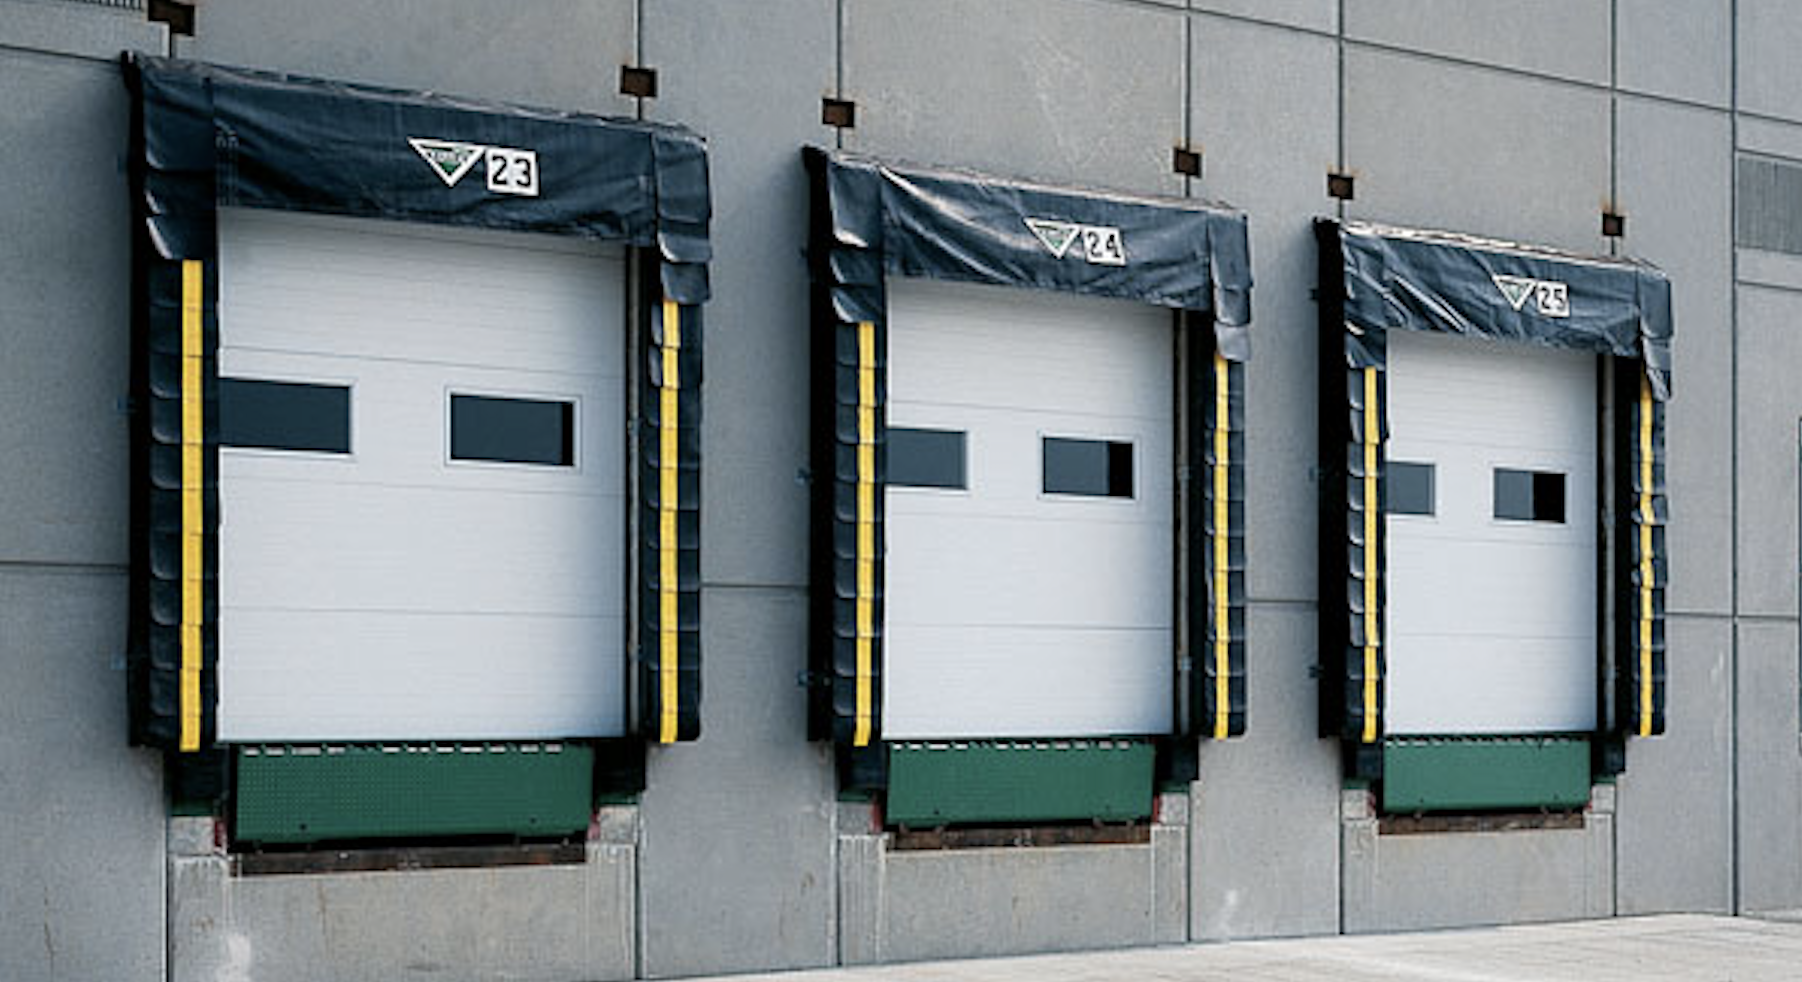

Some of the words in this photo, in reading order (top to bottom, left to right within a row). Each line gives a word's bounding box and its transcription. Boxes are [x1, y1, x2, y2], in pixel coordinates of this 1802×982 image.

[491, 155, 531, 187] 23
[1087, 231, 1121, 258] 24
[1540, 287, 1566, 312] 25
